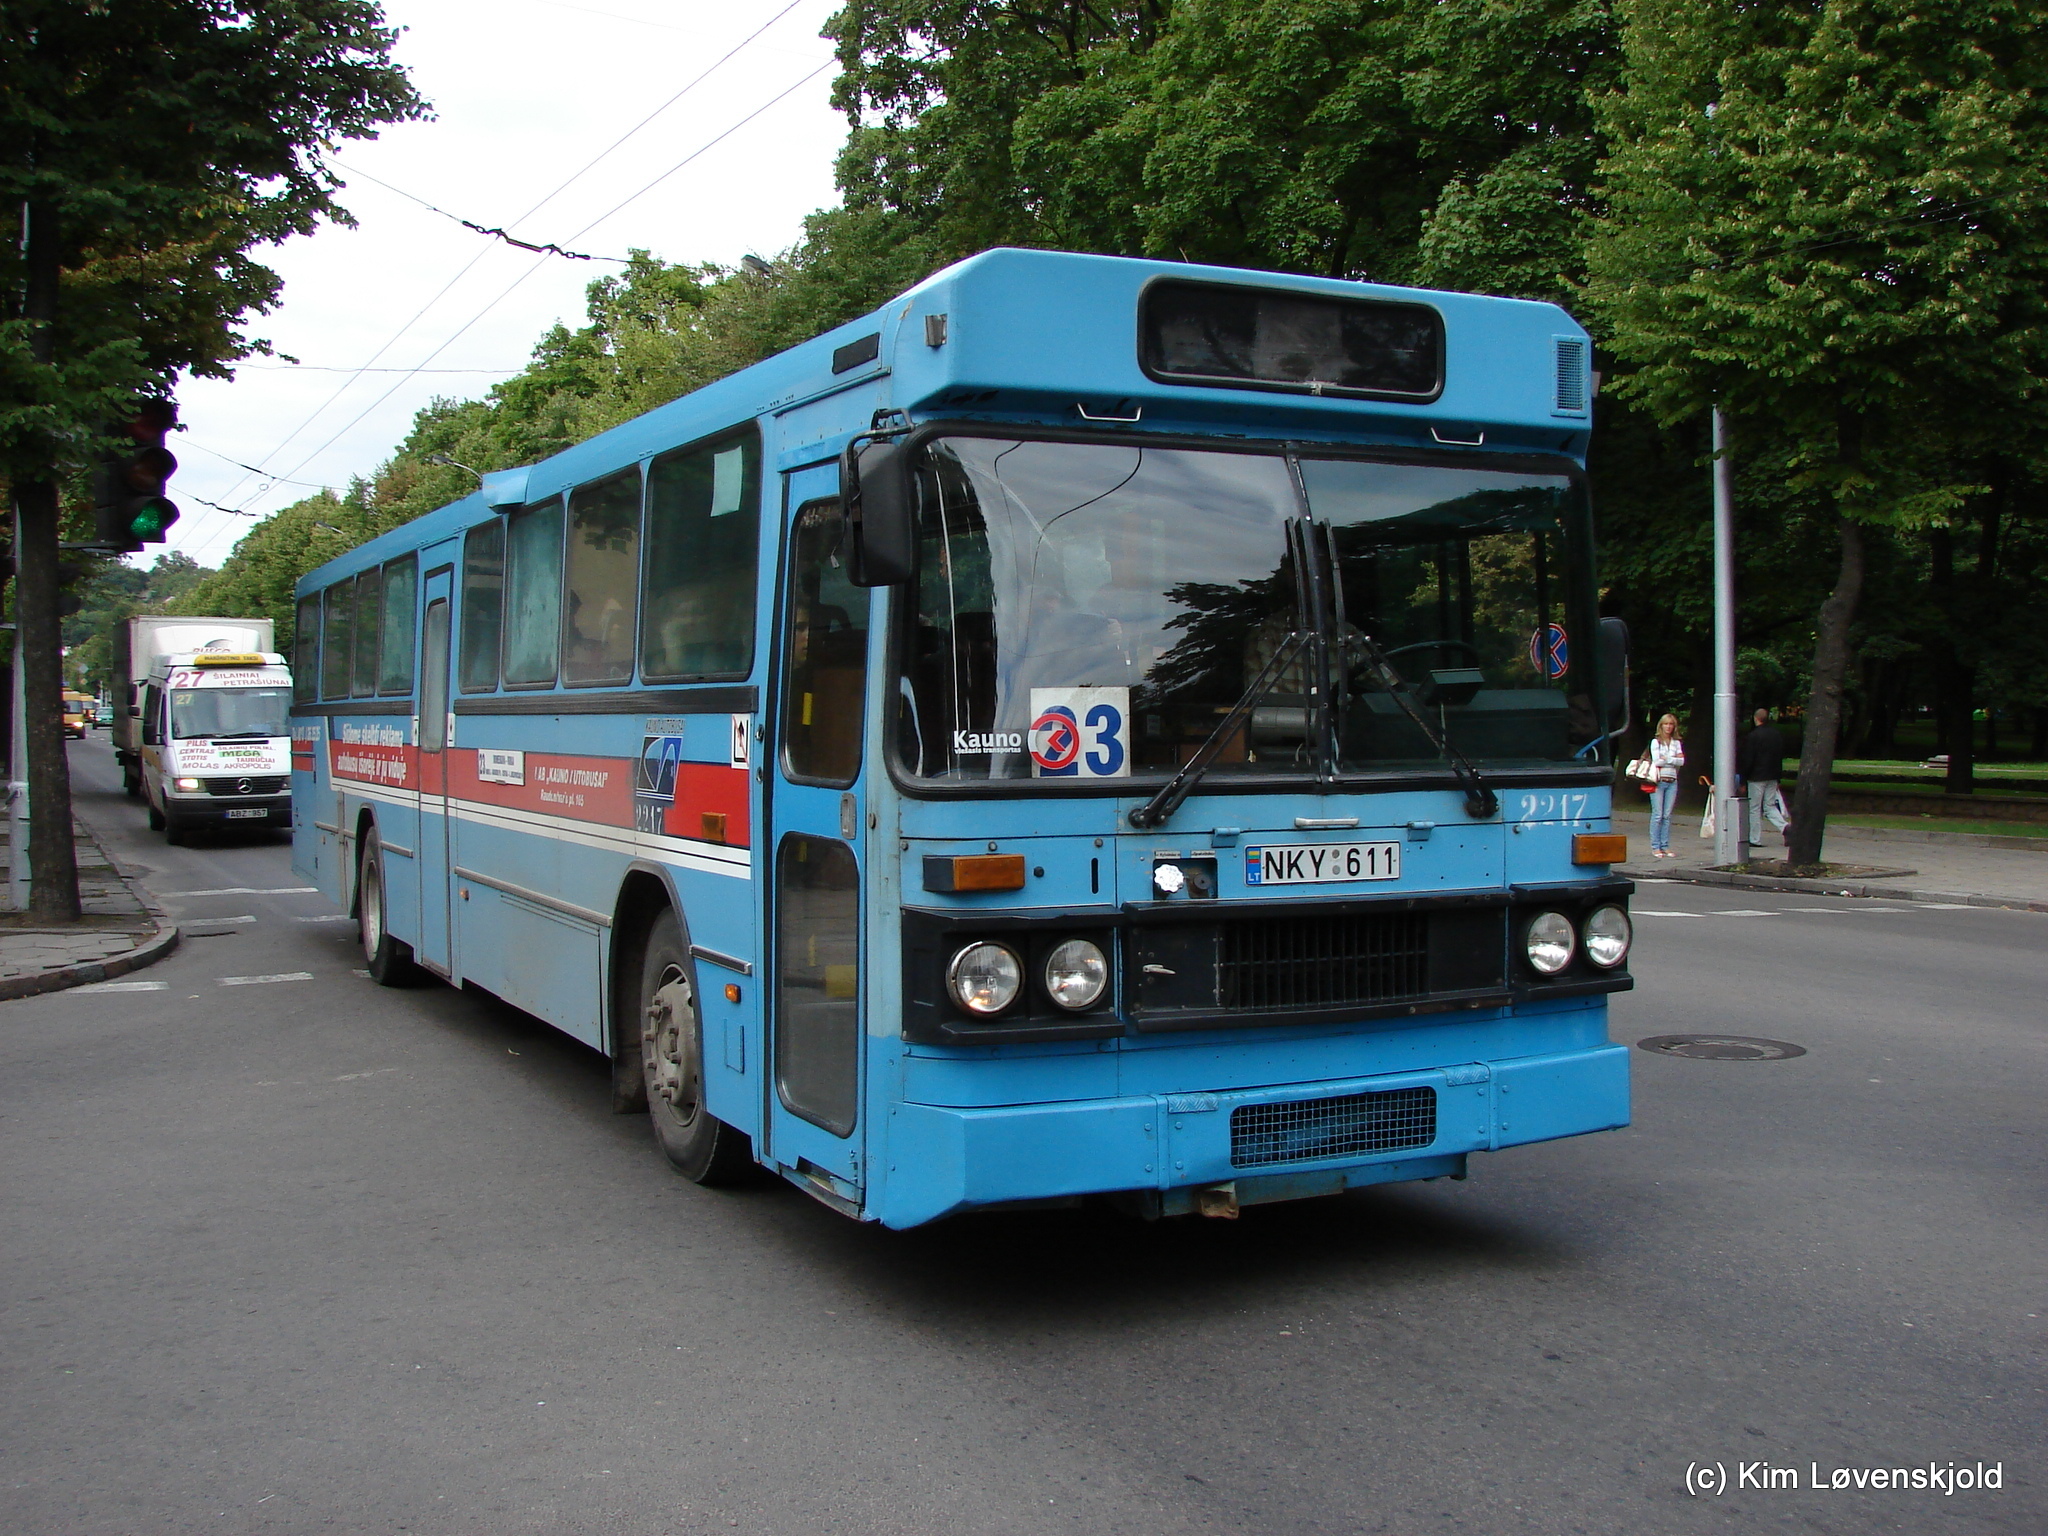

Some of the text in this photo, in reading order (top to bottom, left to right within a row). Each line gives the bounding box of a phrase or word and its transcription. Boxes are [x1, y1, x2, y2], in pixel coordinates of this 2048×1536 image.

[175, 671, 206, 689] 27
[175, 693, 193, 705] 27
[953, 730, 1022, 749] Kauno
[1039, 703, 1124, 777] 23
[983, 747, 1022, 755] transportas
[635, 804, 663, 835] 2217
[1519, 793, 1588, 830] 2217
[1264, 846, 1394, 880] NKY 611
[1247, 872, 1261, 882] LT
